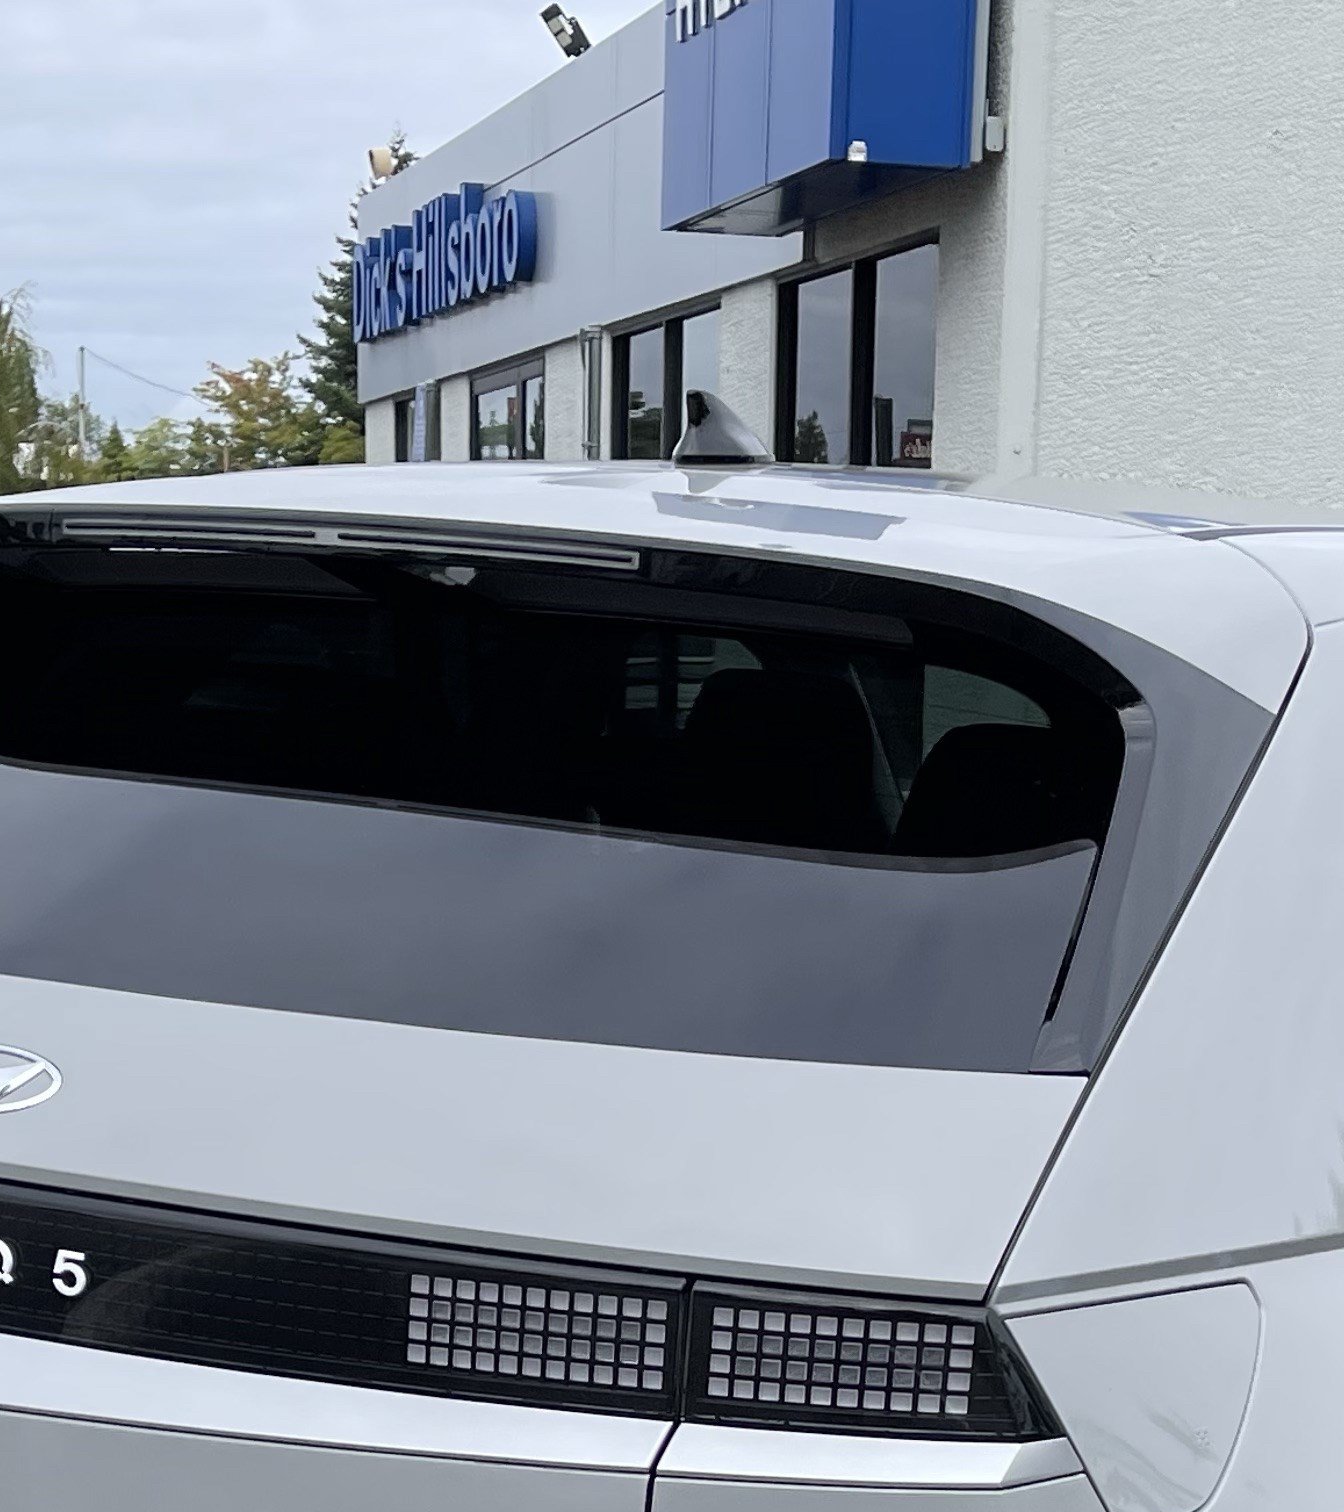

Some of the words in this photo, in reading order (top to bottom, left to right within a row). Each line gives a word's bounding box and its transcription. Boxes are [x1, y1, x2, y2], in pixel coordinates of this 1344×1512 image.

[352, 225, 407, 343] Dick's
[412, 182, 519, 320] Hillsboro
[52, 1249, 88, 1297] 5
